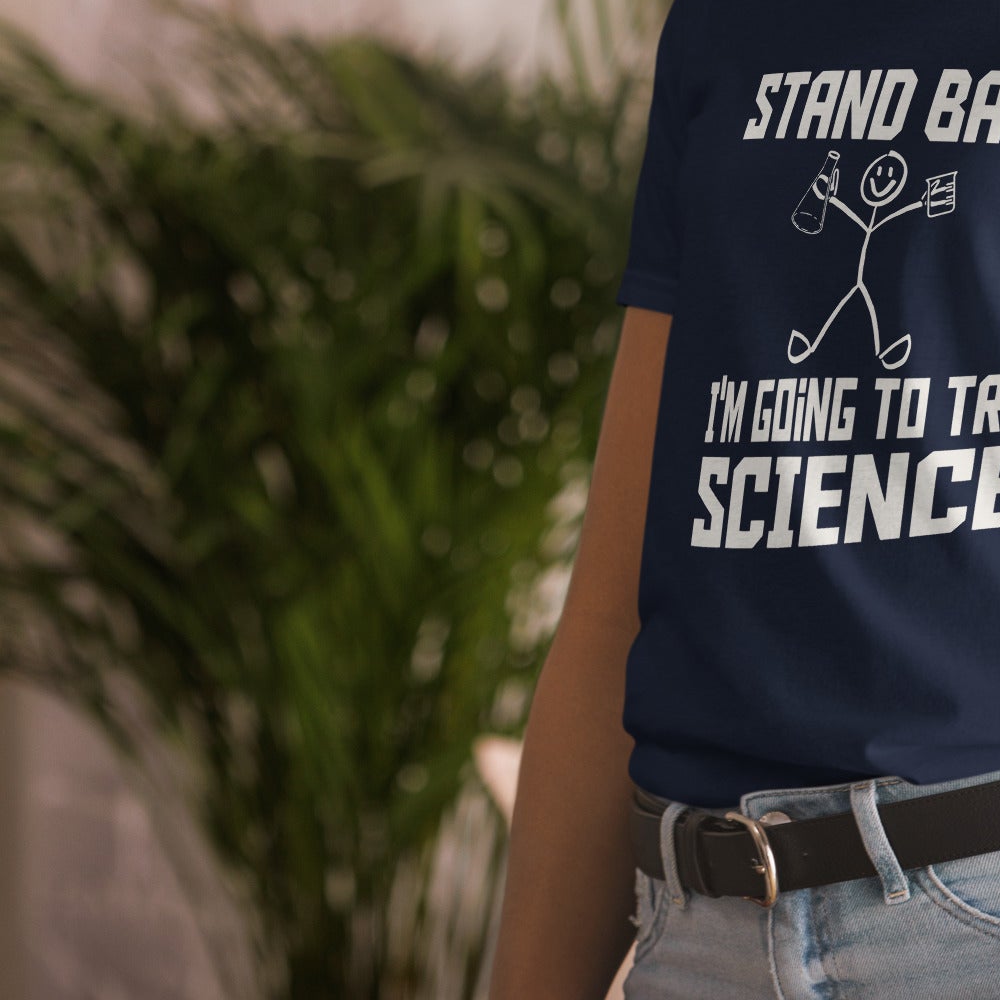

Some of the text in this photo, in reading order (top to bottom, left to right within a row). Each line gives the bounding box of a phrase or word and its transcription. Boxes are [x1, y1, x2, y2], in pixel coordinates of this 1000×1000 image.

[743, 69, 919, 140] STAND
[705, 375, 748, 443] I'M
[875, 378, 931, 440] TO
